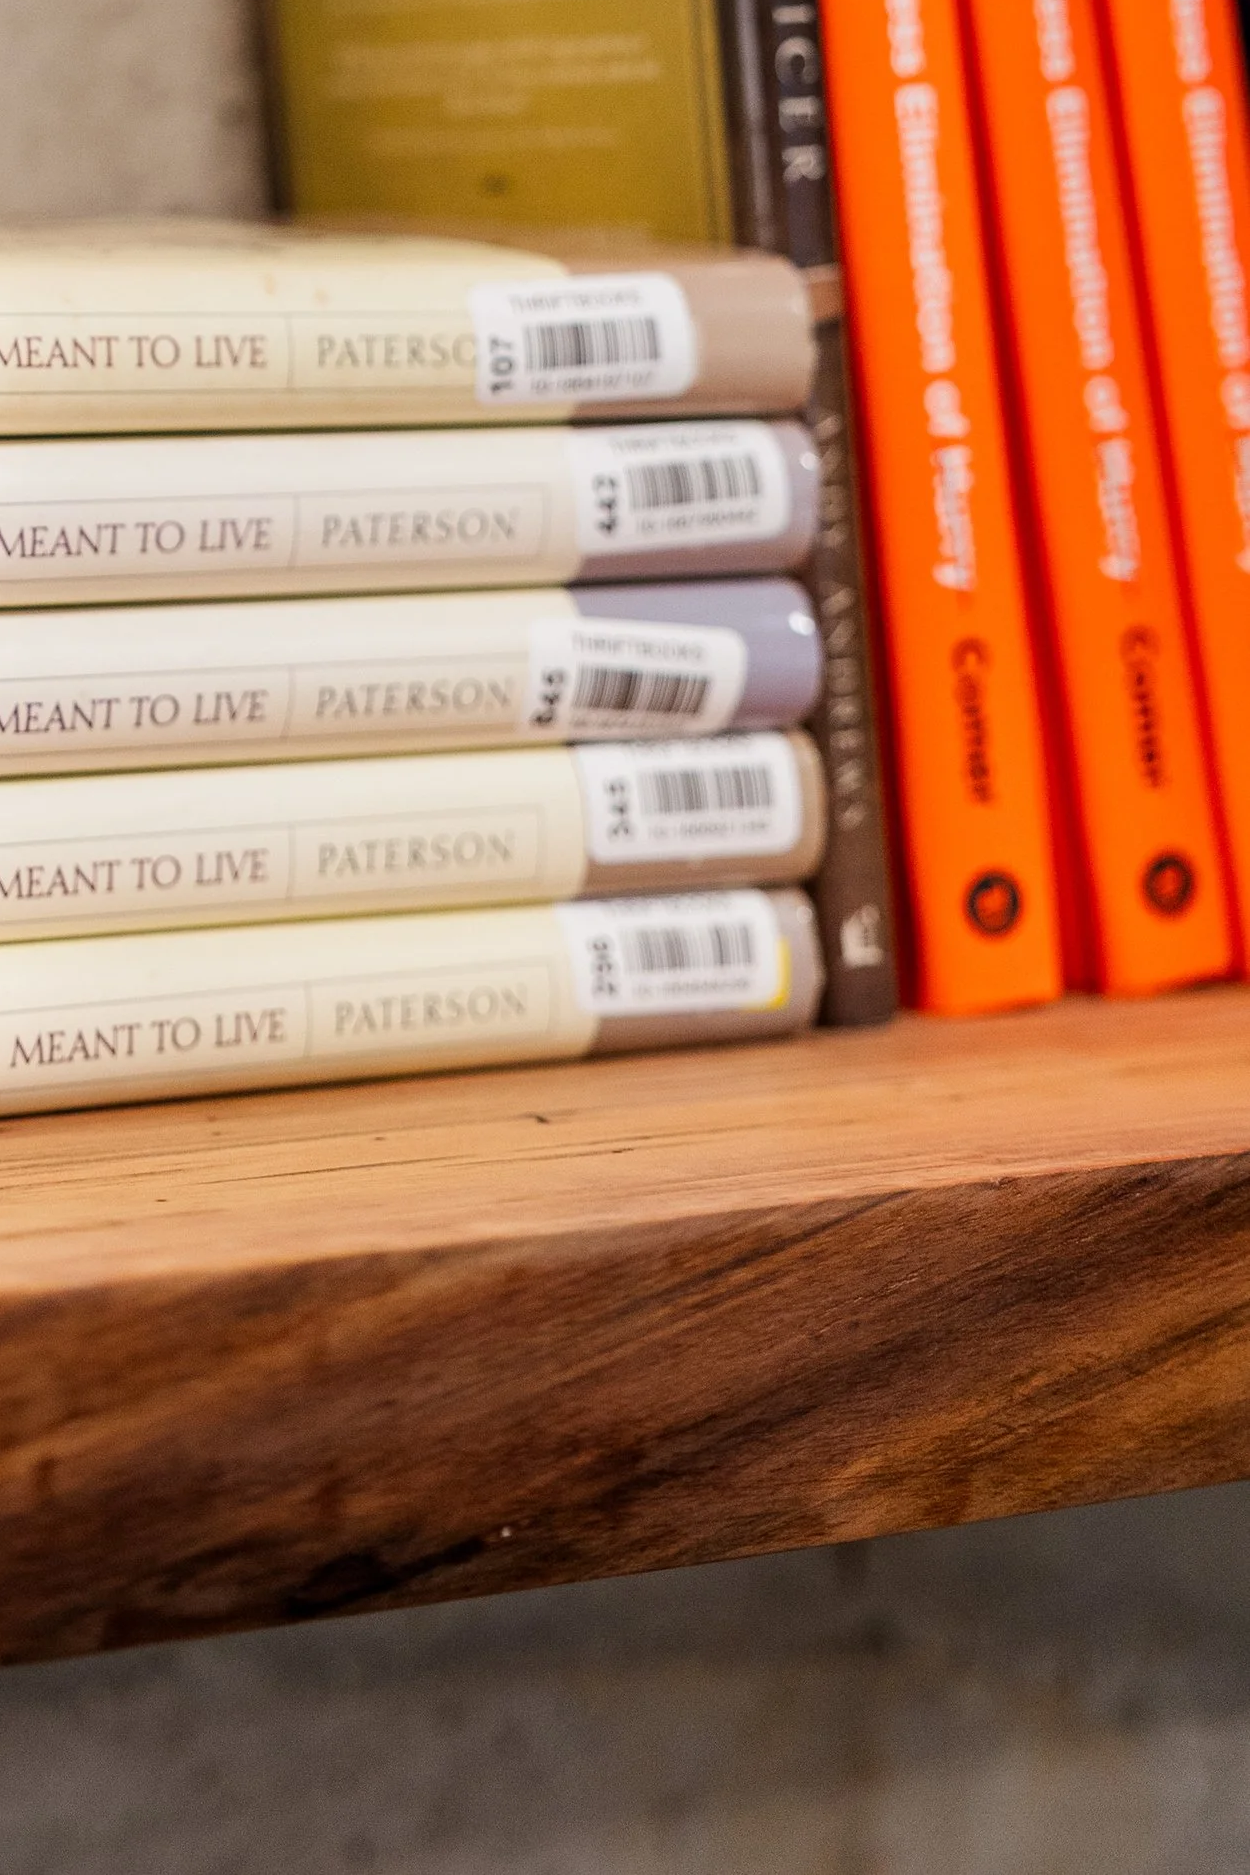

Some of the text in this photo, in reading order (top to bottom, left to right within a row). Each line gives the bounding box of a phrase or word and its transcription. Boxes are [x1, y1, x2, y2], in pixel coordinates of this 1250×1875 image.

[893, 83, 956, 372] Elimination
[1045, 86, 1114, 370] Elimination
[1083, 374, 1129, 432] of
[128, 335, 181, 369] TO
[194, 335, 267, 369] LIVE
[317, 334, 474, 369] PATERSO
[489, 336, 514, 394] 107
[924, 379, 971, 438] of
[135, 521, 186, 554] TO
[198, 518, 272, 553] LIVE
[322, 508, 519, 547] PATERSON
[129, 695, 180, 729] TO
[193, 690, 268, 726] LIVE
[315, 676, 513, 719] PATERSON
[130, 855, 182, 891] TO
[195, 848, 268, 887] LIVE
[317, 828, 515, 878] PATERSON
[335, 983, 527, 1034] PATERSON
[10, 1023, 141, 1068] MEANT
[150, 1018, 202, 1054] TO
[214, 1008, 285, 1049] LIVE
